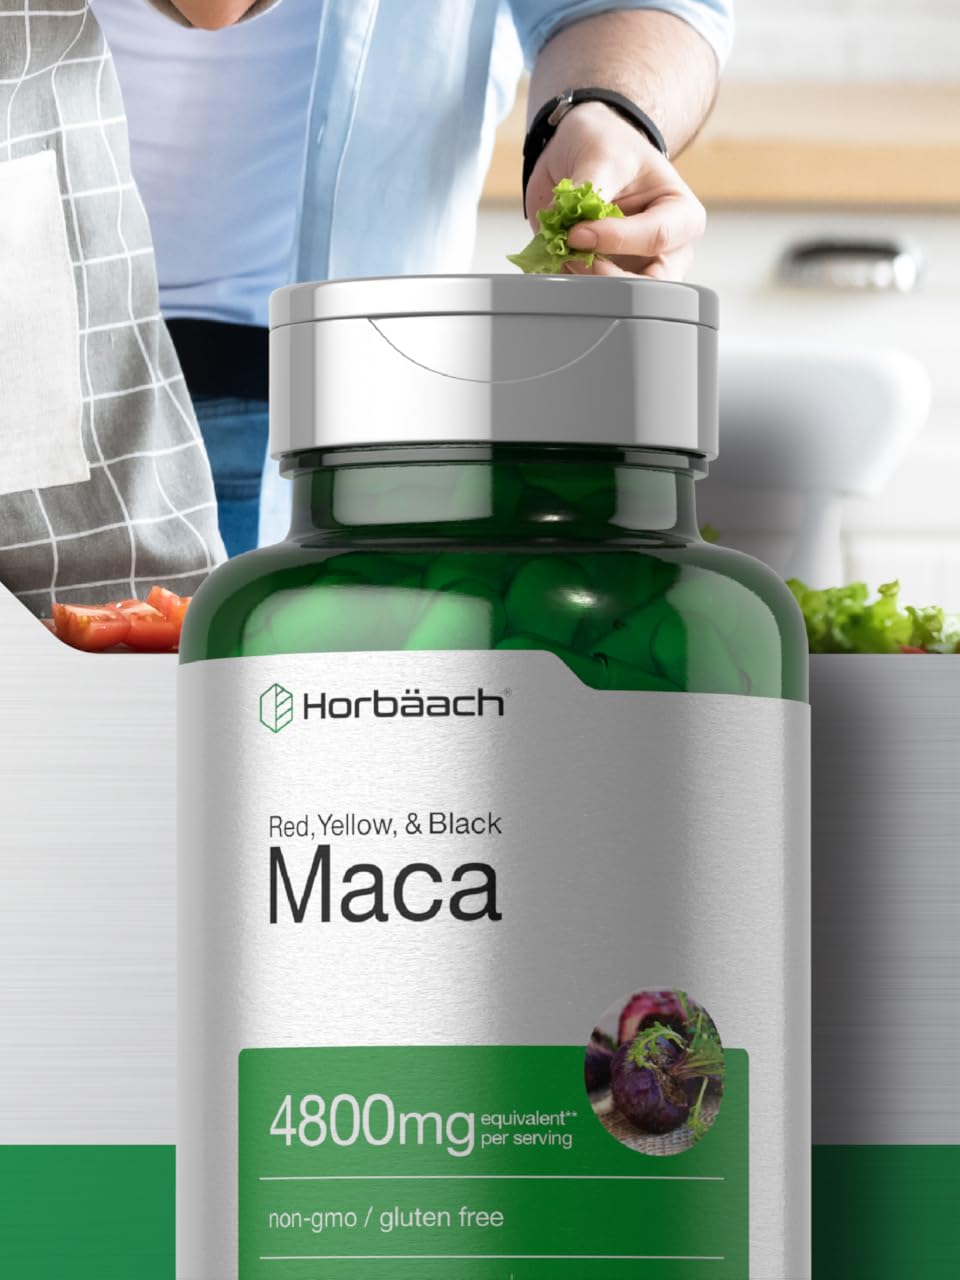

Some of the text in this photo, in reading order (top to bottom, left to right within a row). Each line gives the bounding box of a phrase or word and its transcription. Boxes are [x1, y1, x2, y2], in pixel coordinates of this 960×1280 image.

[405, 812, 423, 835] &
[428, 811, 503, 835] Black
[269, 843, 504, 924] Maca
[269, 1093, 476, 1158] 4800mg
[481, 1130, 573, 1149] per serving
[269, 1211, 358, 1233] non-gmo
[379, 1206, 451, 1233] gluten
[458, 1205, 505, 1228] free
